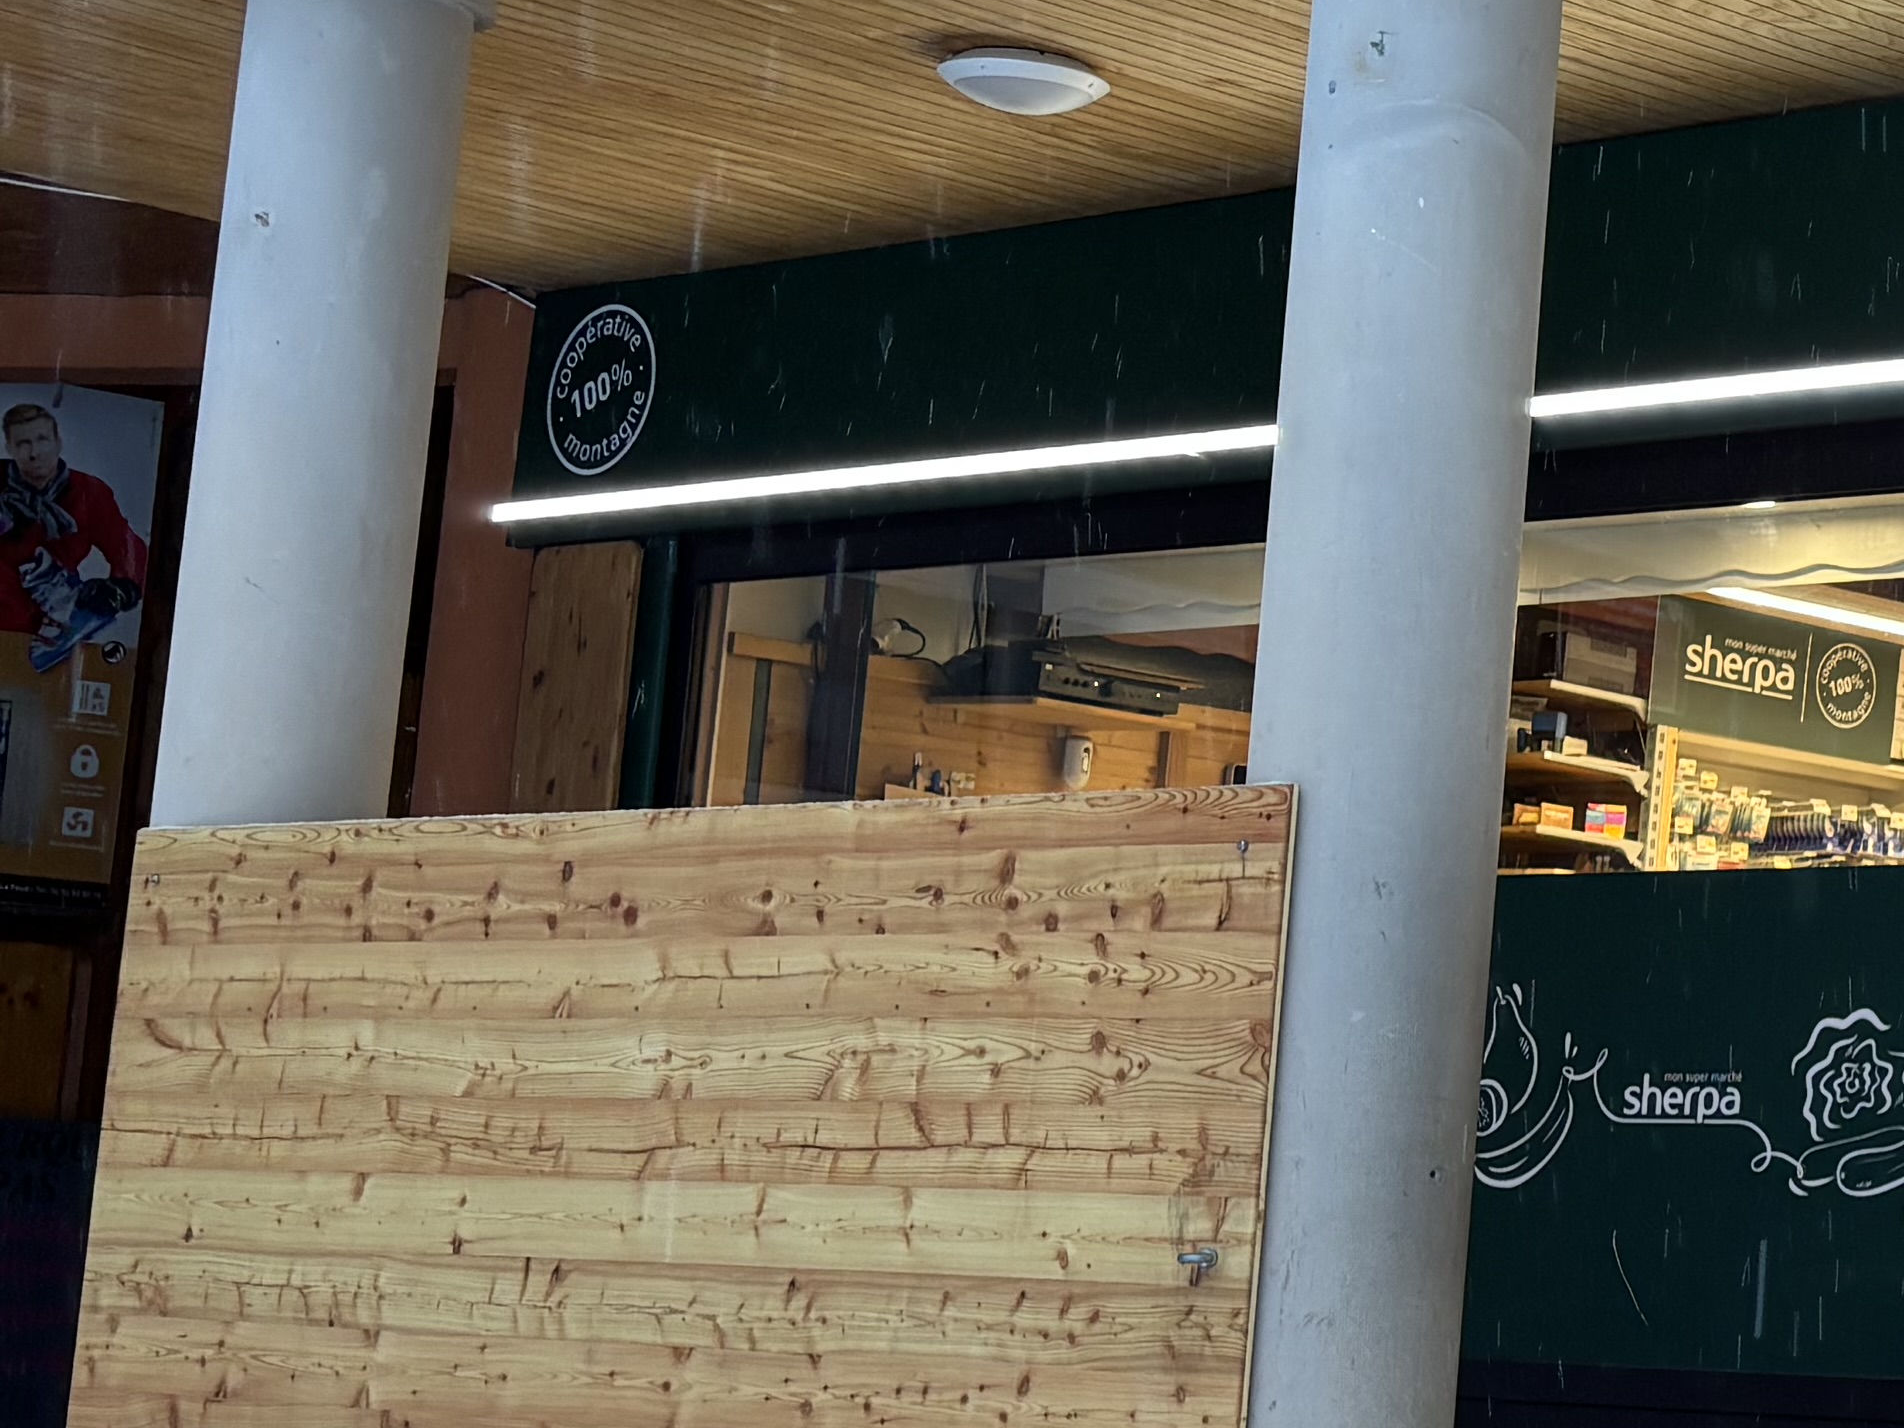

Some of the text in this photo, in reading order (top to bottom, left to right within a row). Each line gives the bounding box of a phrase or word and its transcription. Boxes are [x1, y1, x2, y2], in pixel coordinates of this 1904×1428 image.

[554, 314, 643, 400] coopérative
[569, 358, 633, 419] 100%
[563, 389, 646, 462] montagne
[1685, 634, 1796, 694] sherpa
[1820, 647, 1868, 684] coopérative
[1828, 673, 1865, 698] 100%
[1827, 691, 1872, 722] montagne
[1623, 1072, 1741, 1124] sherpa
